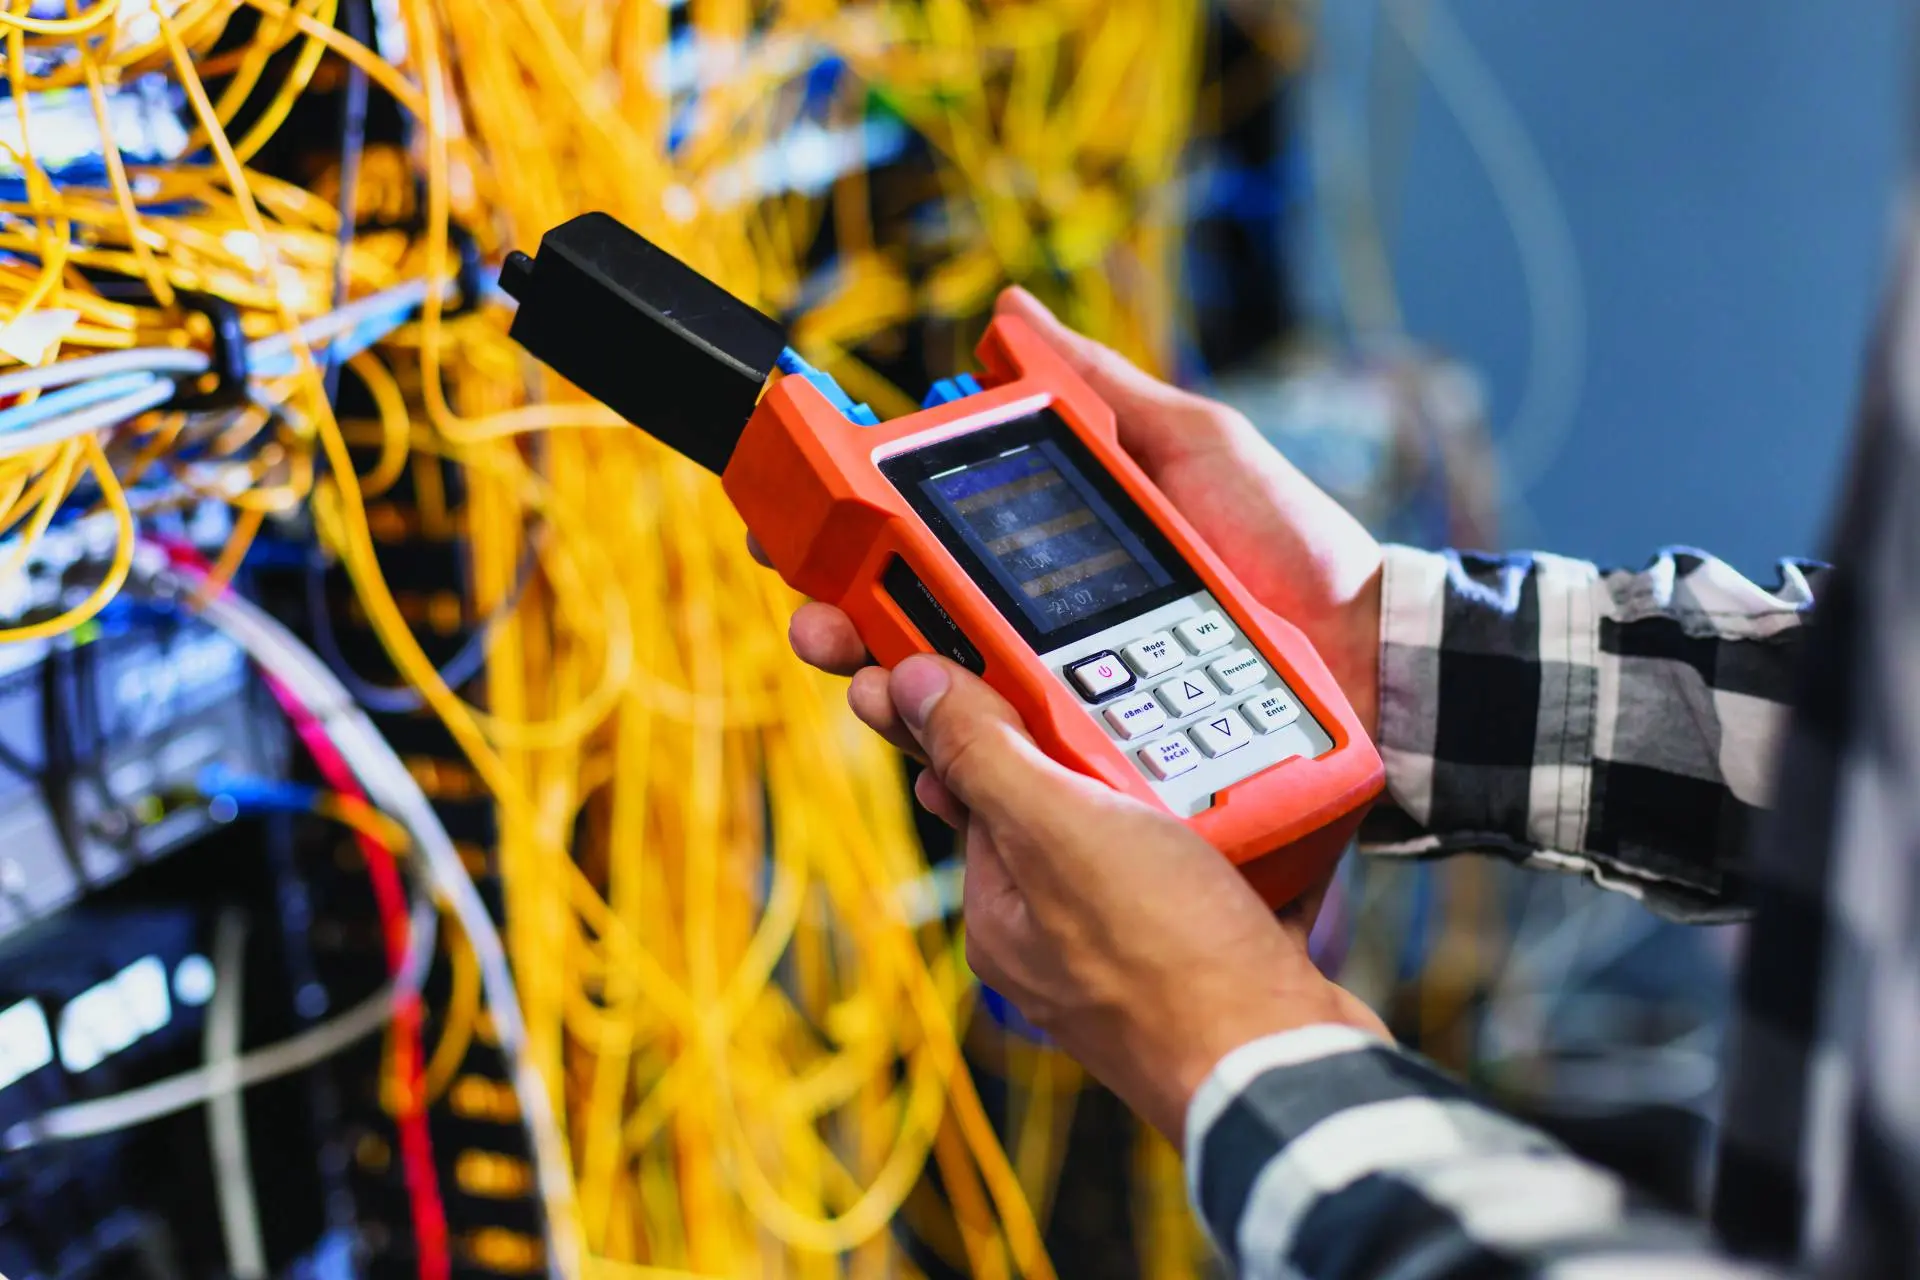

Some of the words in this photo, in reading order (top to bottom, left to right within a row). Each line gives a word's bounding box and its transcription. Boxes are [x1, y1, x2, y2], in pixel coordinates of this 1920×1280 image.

[1196, 622, 1219, 635] VFL
[1142, 640, 1166, 653] Mode
[1153, 648, 1166, 659] F/P
[1222, 657, 1259, 677] Threshold
[1123, 702, 1155, 719] dBm/dB
[1265, 704, 1287, 717] Enter
[1160, 742, 1180, 753] Save
[1163, 747, 1190, 763] ReCall
